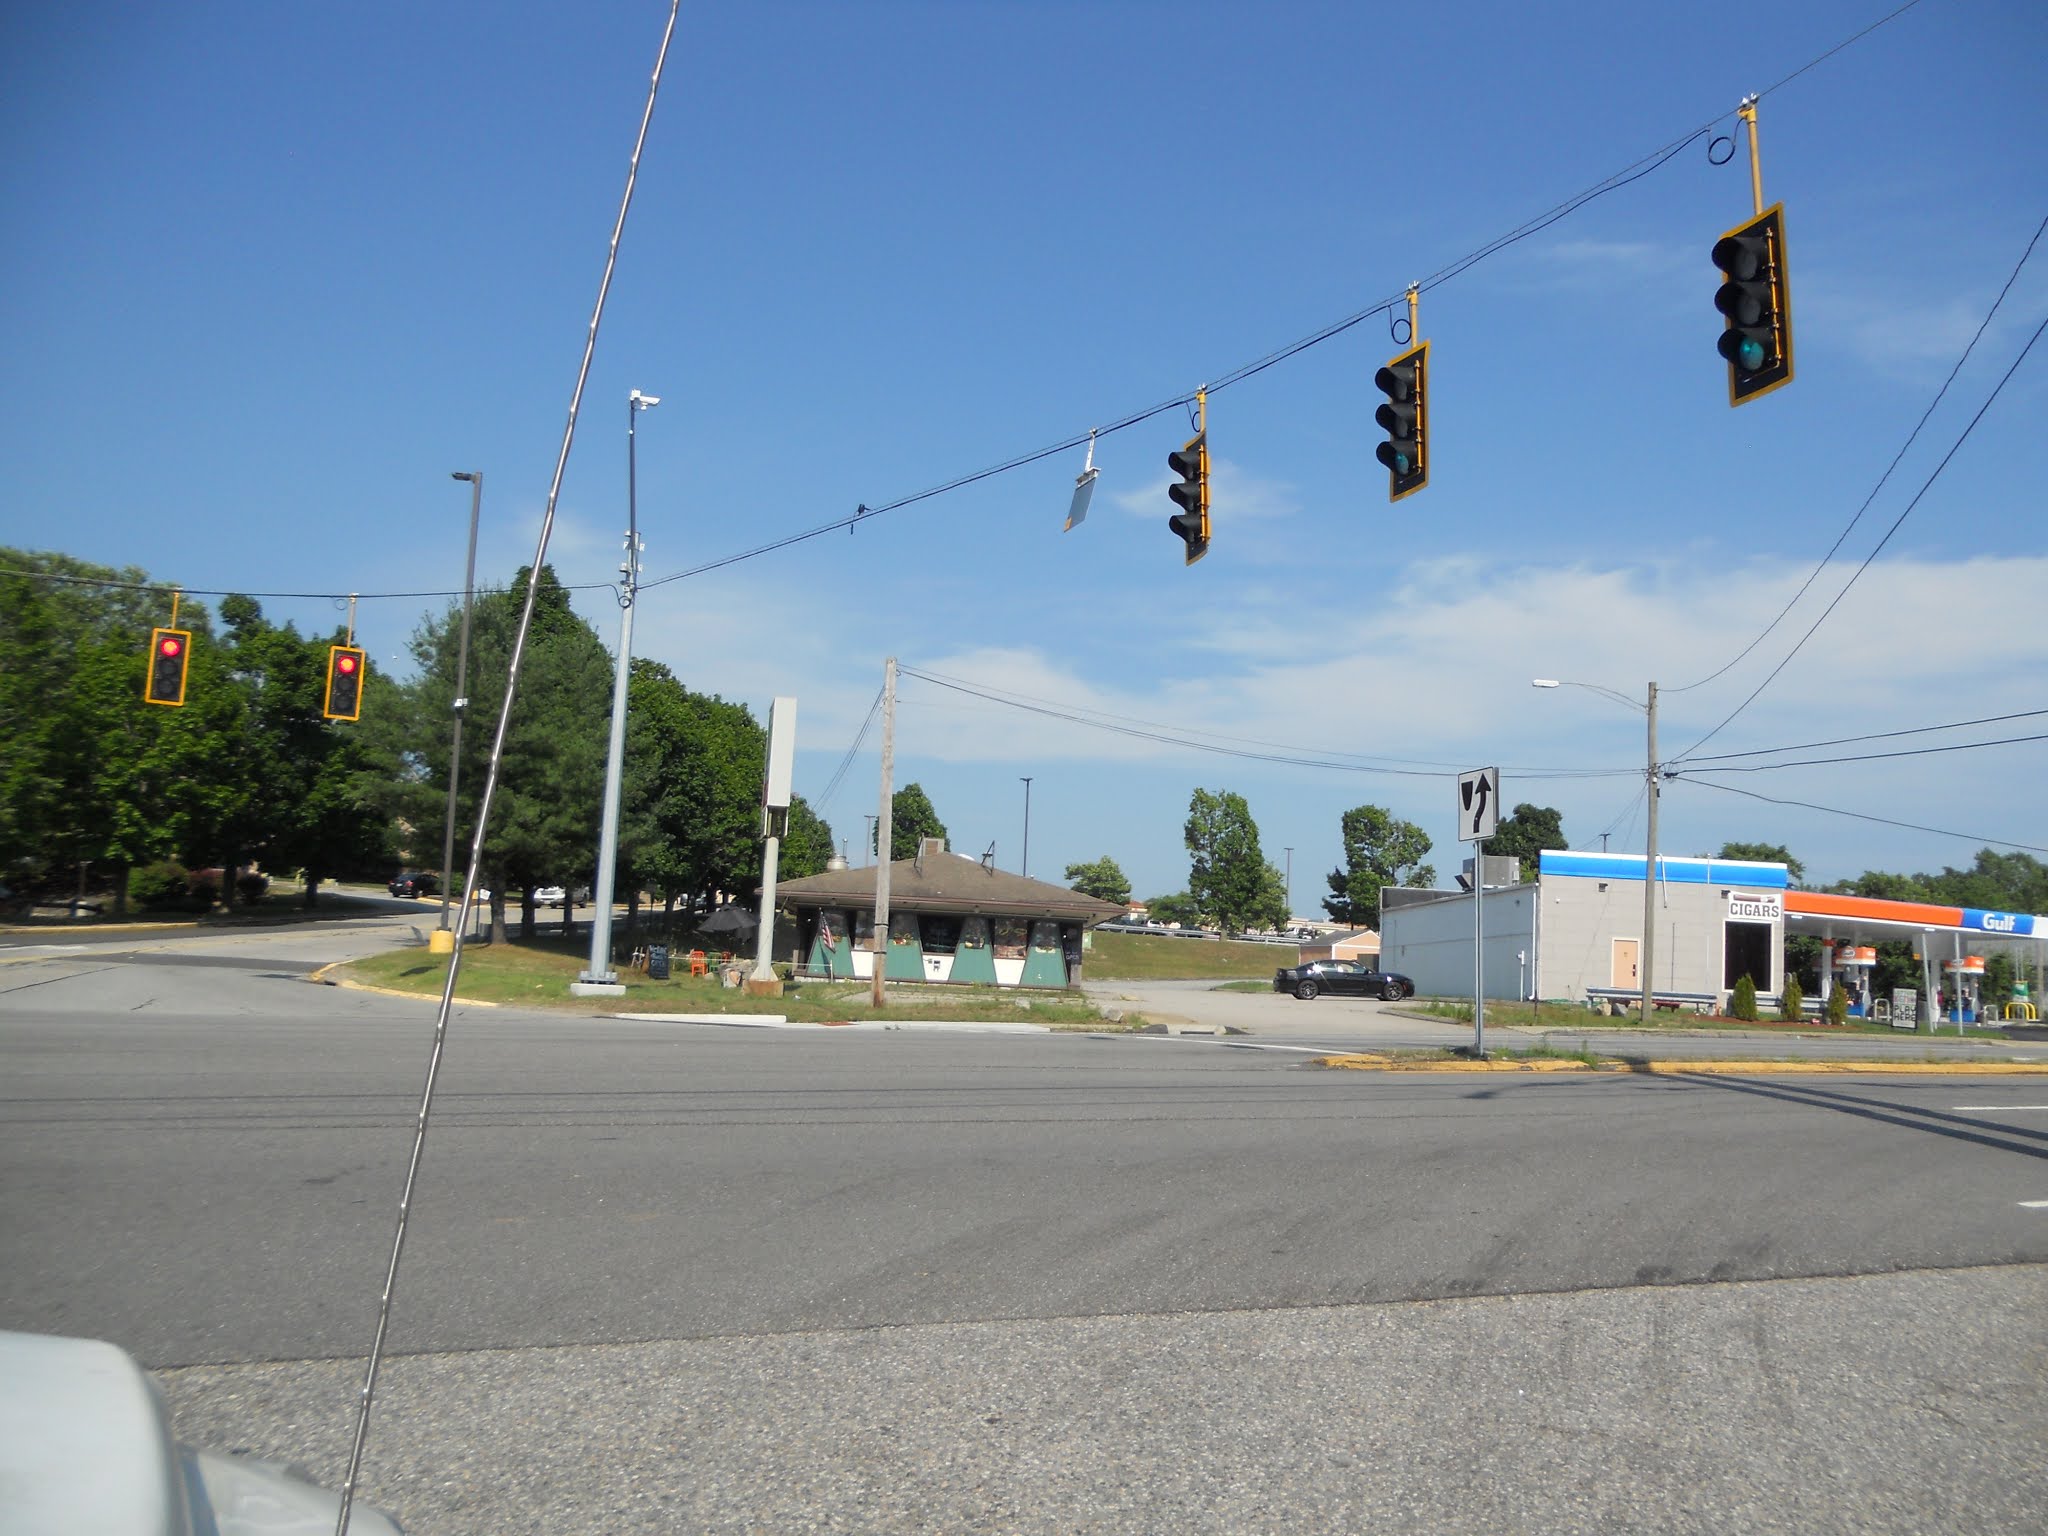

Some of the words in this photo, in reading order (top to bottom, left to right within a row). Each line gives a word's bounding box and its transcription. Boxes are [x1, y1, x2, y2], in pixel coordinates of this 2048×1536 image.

[1730, 902, 1780, 918] CIGARS
[1983, 913, 2015, 931] Gulf
[1894, 1004, 1917, 1013] PLAY
[1894, 1012, 1916, 1022] HERE
